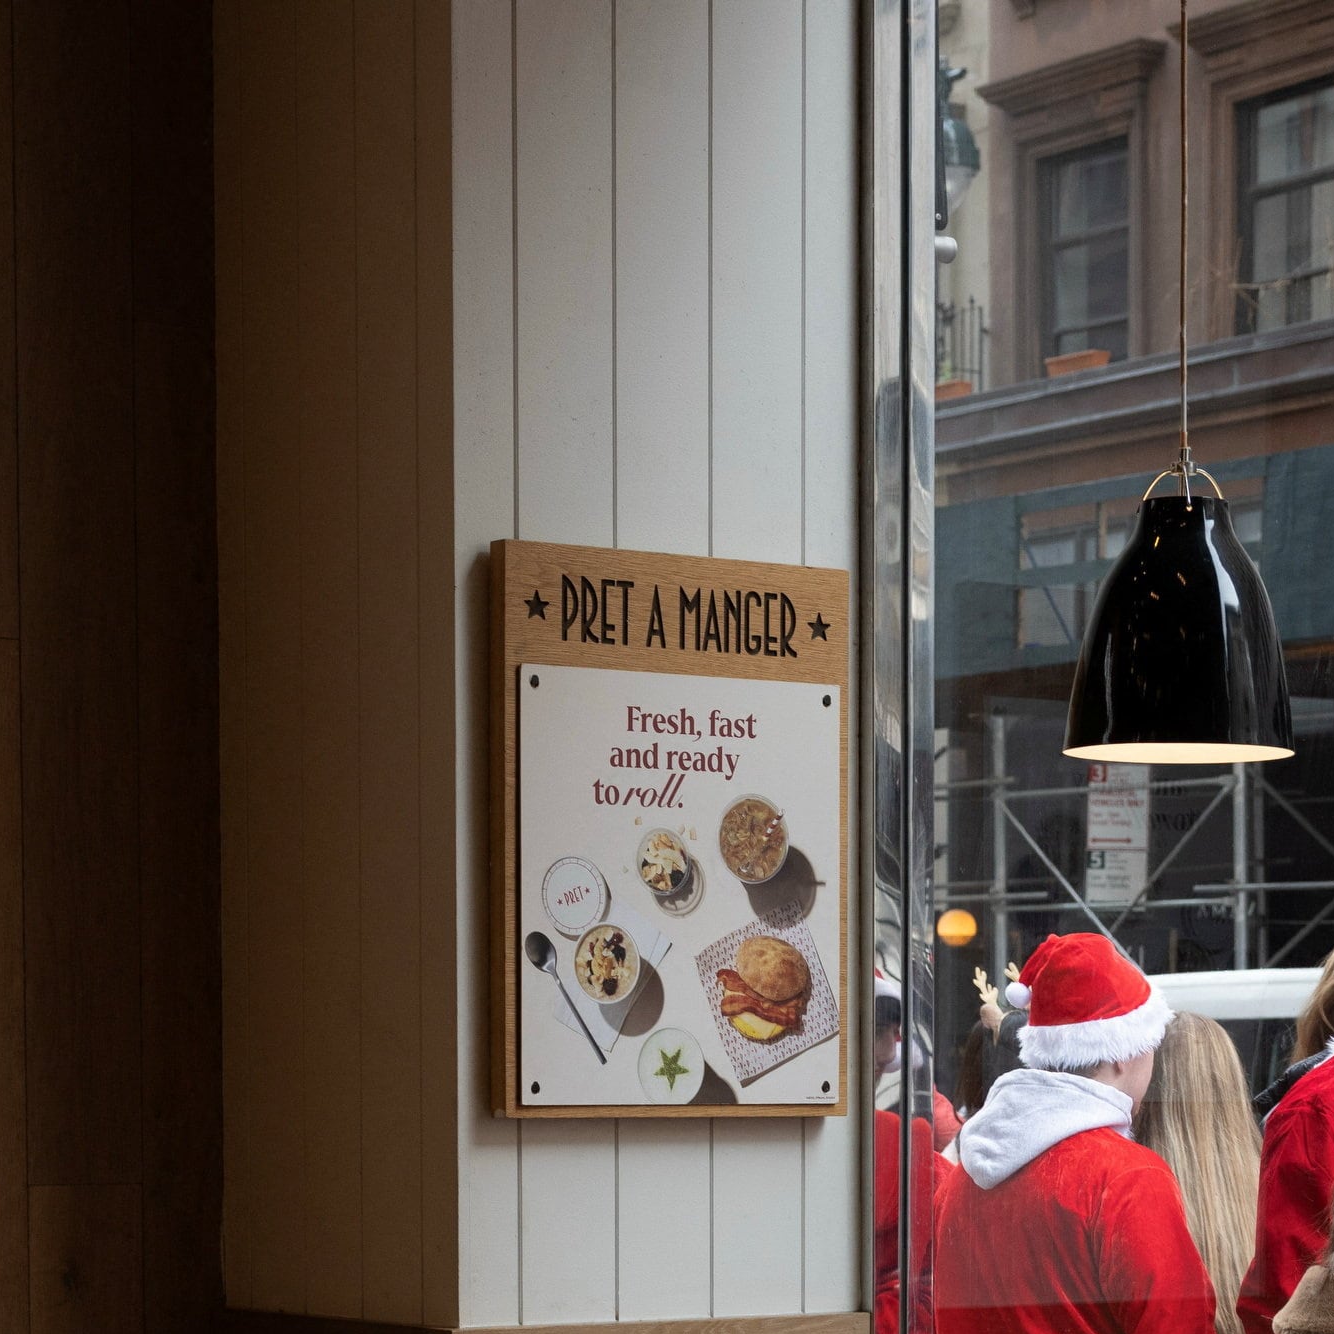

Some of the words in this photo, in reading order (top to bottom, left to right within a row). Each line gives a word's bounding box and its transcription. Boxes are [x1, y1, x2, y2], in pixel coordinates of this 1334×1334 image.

[559, 573, 636, 647] PRET
[646, 583, 667, 650] A
[678, 584, 799, 659] MANGER
[626, 705, 702, 740] Fresh,
[708, 708, 758, 740] fast
[609, 742, 660, 772] and
[666, 746, 741, 781] ready
[592, 777, 620, 806] to
[623, 774, 685, 810] roll.
[563, 886, 584, 906] PRET
